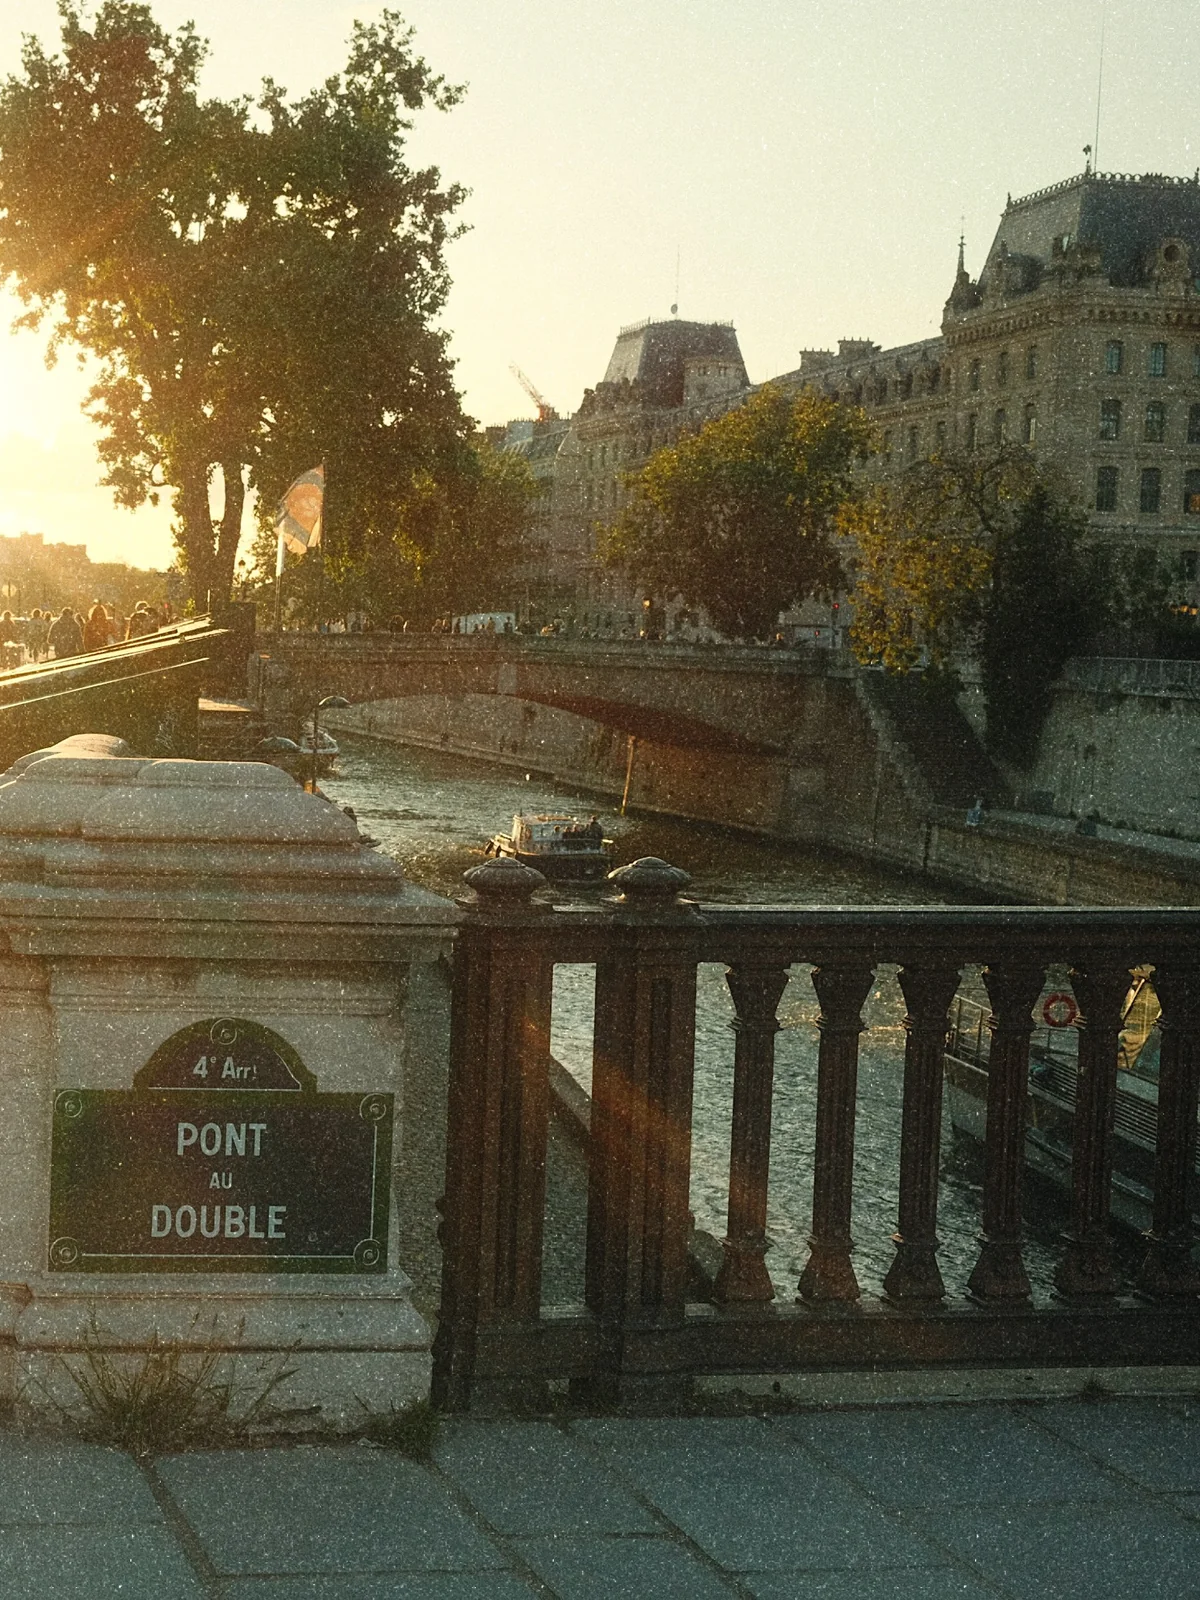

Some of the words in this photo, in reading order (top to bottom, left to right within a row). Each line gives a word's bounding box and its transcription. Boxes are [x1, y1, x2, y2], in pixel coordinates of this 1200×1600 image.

[176, 1122, 267, 1157] PONT
[208, 1171, 233, 1190] AU
[150, 1204, 287, 1239] DOUBLE
